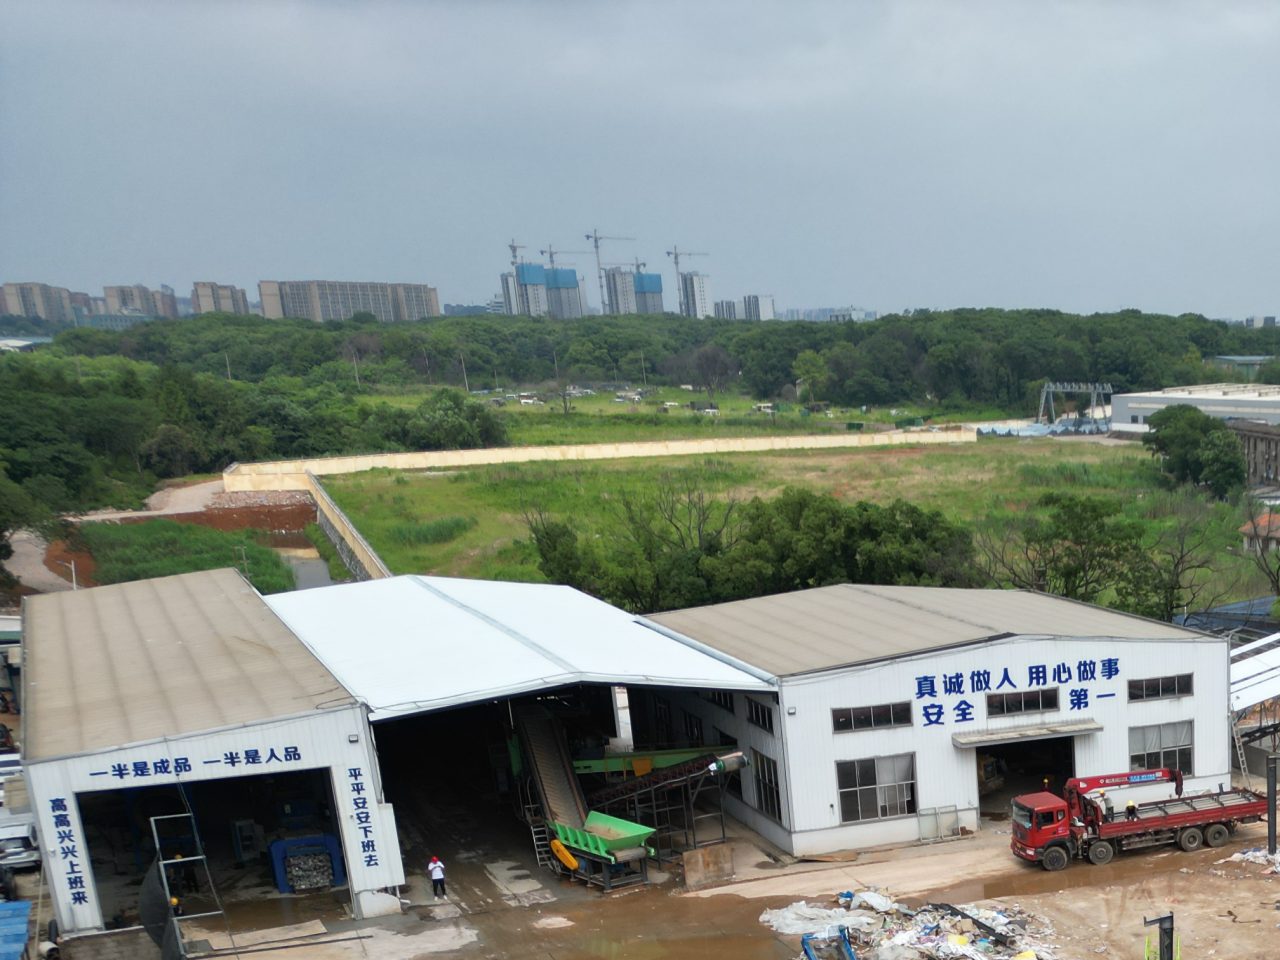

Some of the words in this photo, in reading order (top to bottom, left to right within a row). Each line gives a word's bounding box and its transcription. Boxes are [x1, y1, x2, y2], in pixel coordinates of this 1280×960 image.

[915, 667, 1017, 699] 真诚做人
[1028, 658, 1120, 687] 用心做事
[923, 700, 974, 726] 安全
[1069, 688, 1116, 710] 第一
[89, 757, 192, 779] 一半是成品
[203, 746, 302, 767] 一半是人品
[348, 767, 379, 867] 平平安安下班去
[49, 798, 88, 905] 高高兴兴上班来
